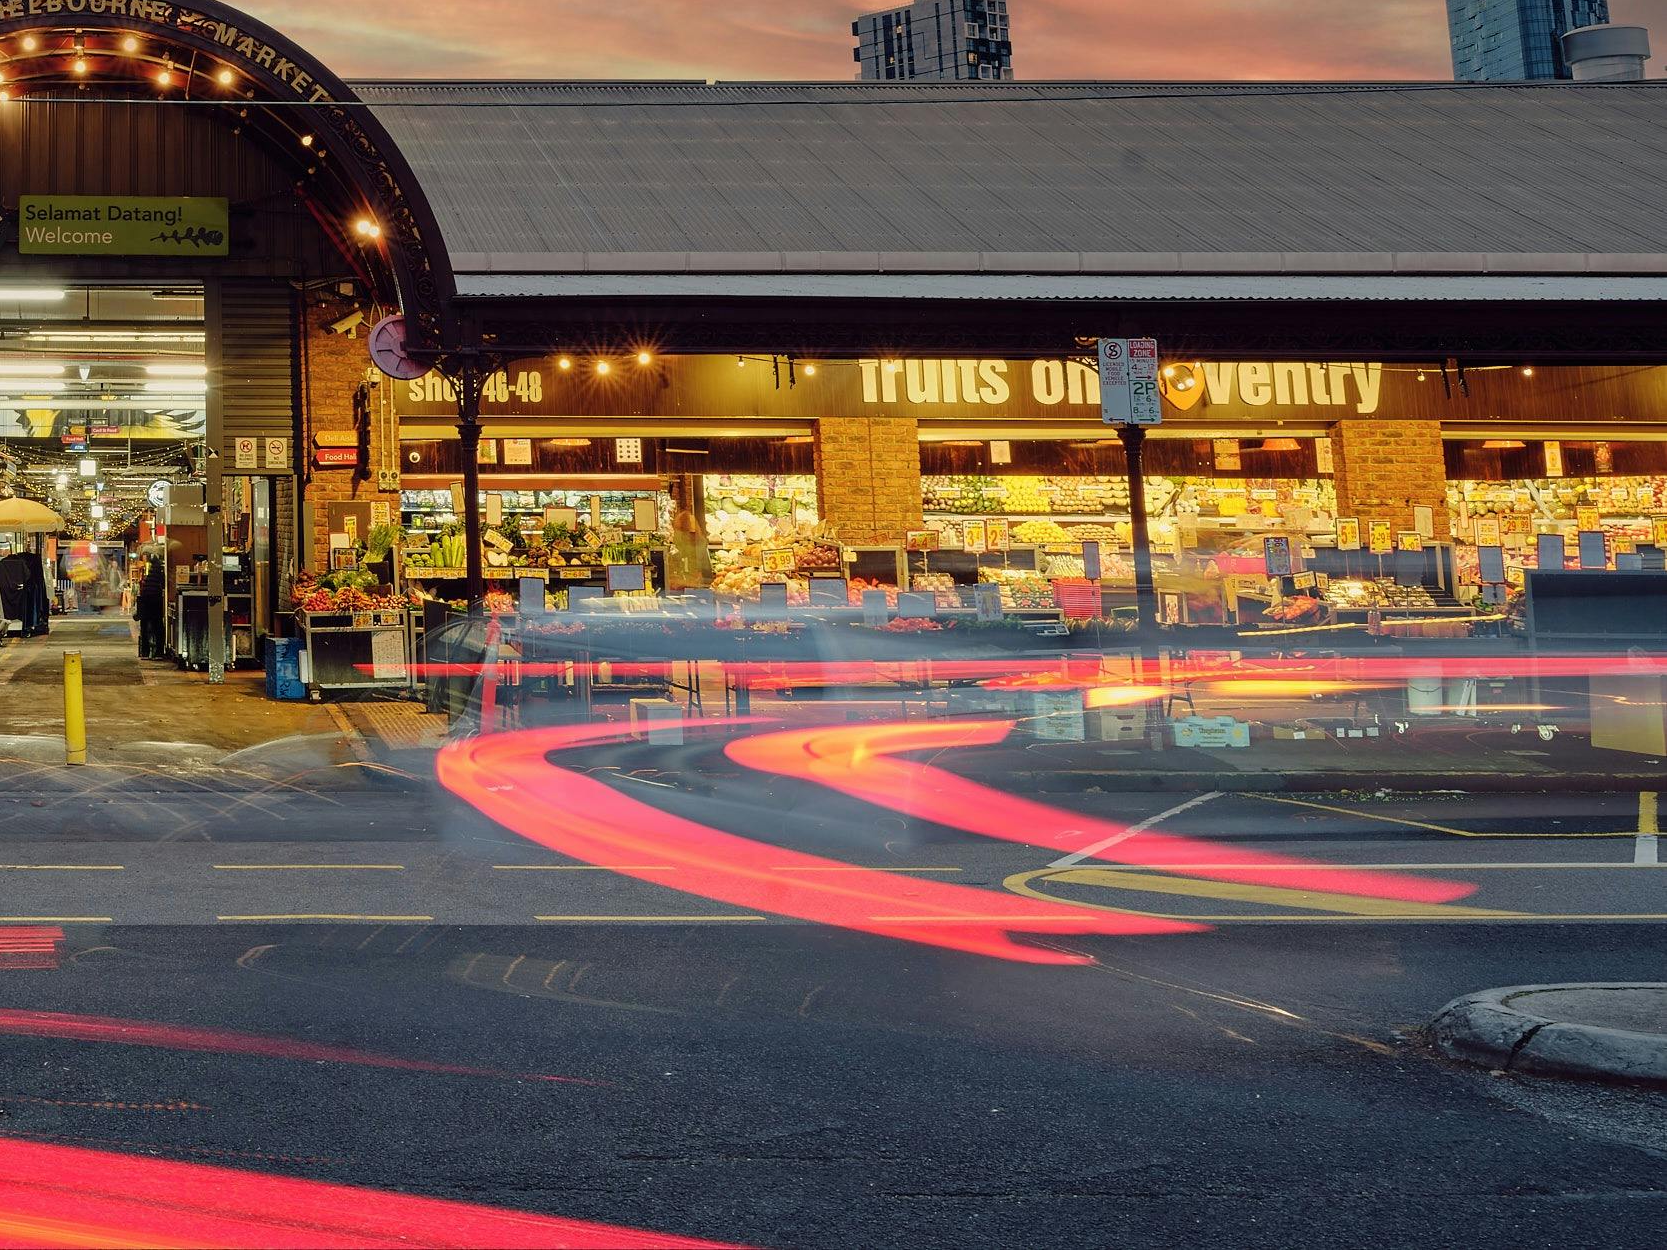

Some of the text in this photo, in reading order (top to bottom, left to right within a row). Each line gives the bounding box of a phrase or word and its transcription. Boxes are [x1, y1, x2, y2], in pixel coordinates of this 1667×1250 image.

[214, 23, 330, 104] MARKET
[25, 205, 183, 225] Selamat Datang!
[25, 226, 113, 244] Welcome
[1129, 341, 1154, 349] LOADING
[1133, 349, 1151, 357] ZONE
[483, 371, 543, 403] 46-48
[858, 360, 1010, 406] fruits
[1033, 360, 1100, 405] on
[1133, 382, 1156, 395] 2P
[325, 452, 343, 461] Food
